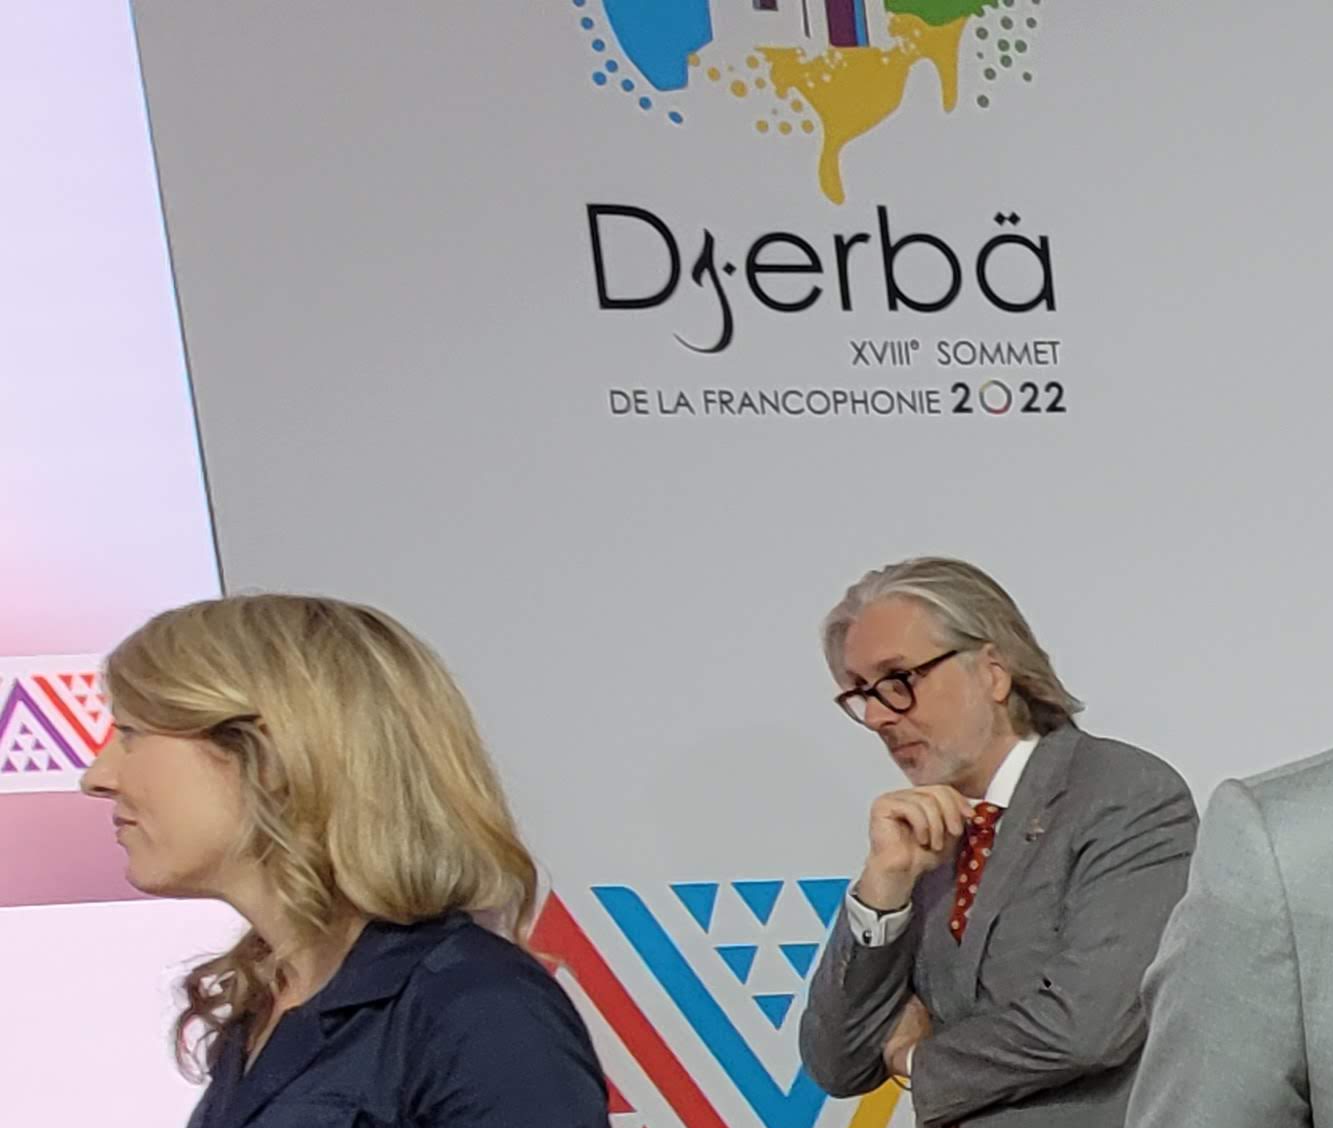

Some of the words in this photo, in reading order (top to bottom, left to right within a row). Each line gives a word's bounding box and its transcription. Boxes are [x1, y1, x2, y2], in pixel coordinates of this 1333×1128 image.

[937, 340, 1060, 366] SOMMET
[610, 389, 648, 415] DE
[658, 389, 695, 415] LA
[704, 387, 941, 415] FRANCOPHONIE
[951, 379, 1066, 415] 2022
